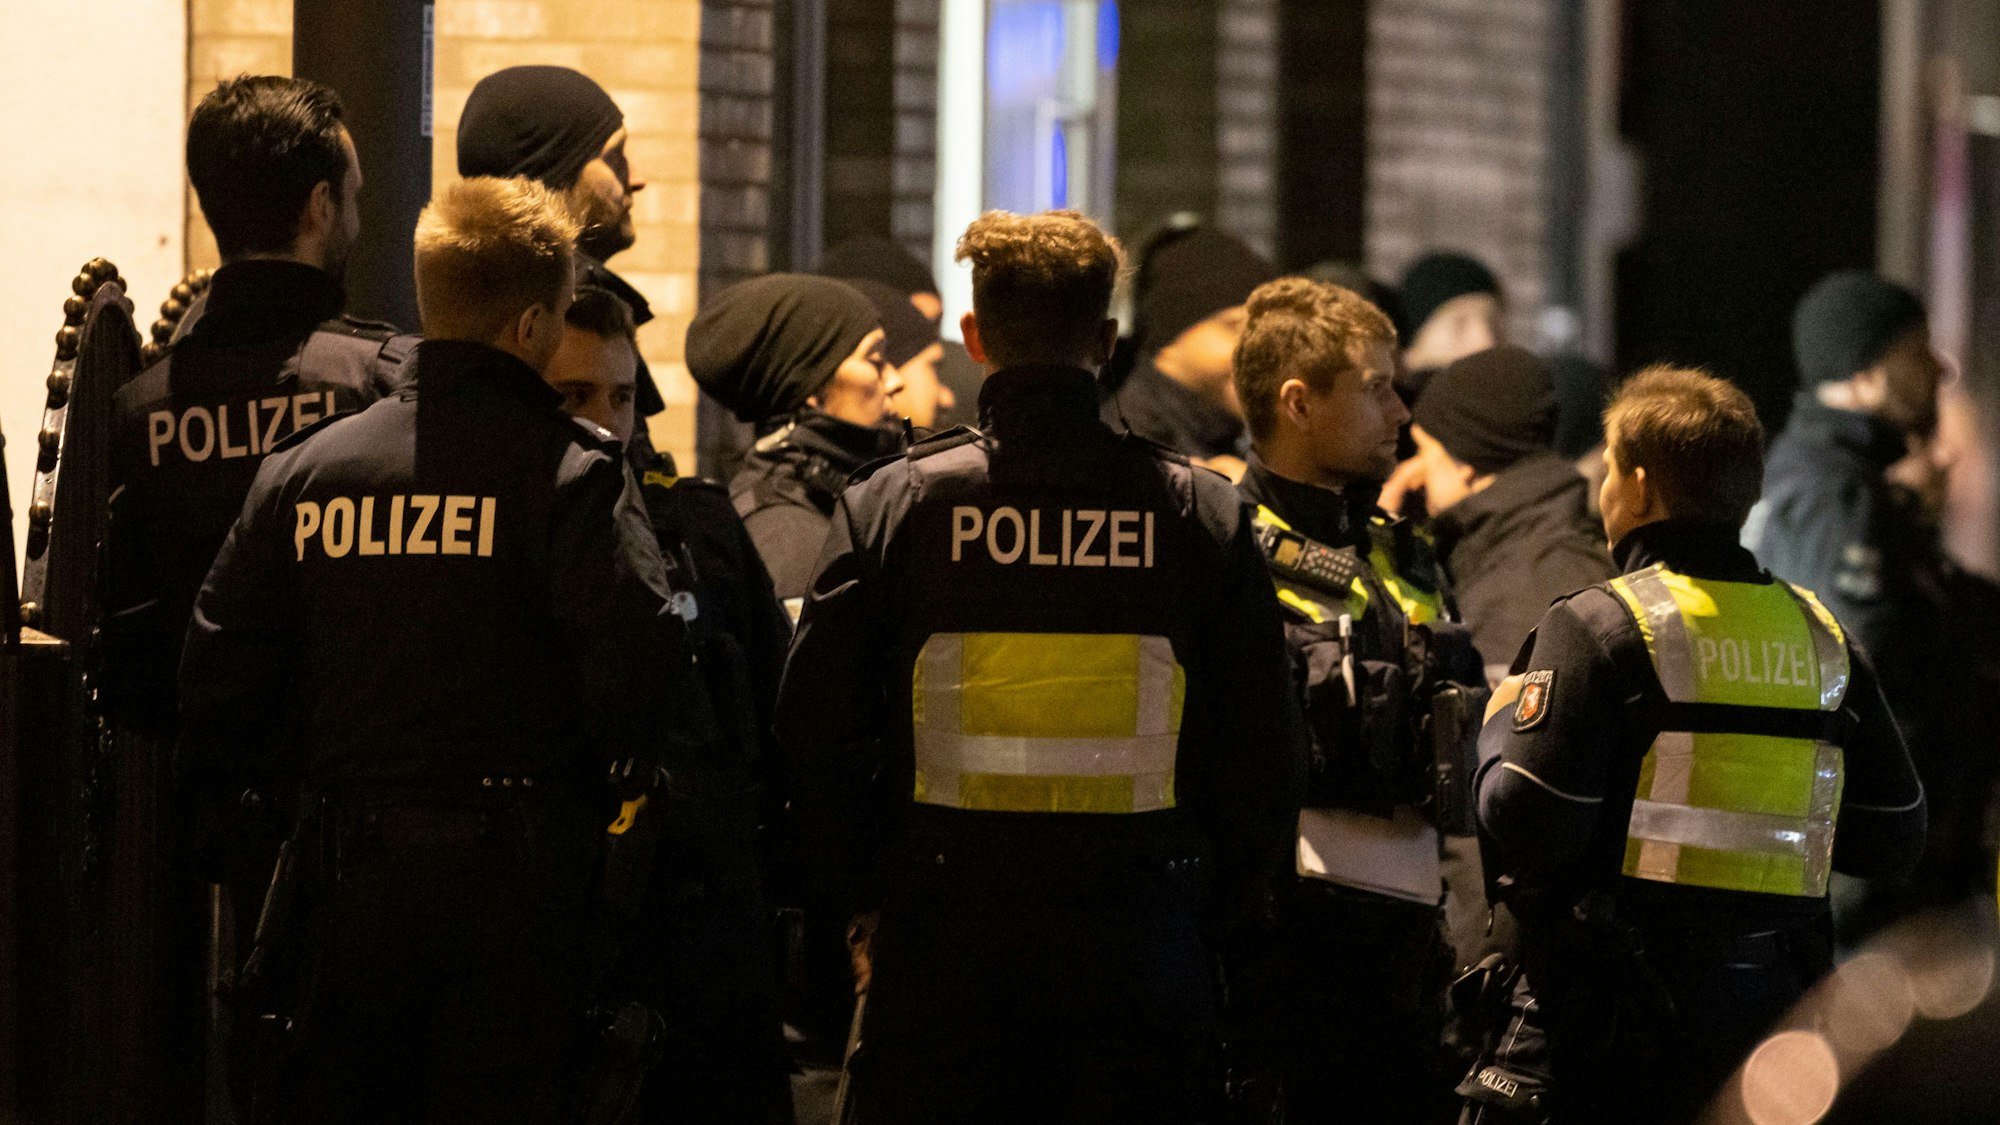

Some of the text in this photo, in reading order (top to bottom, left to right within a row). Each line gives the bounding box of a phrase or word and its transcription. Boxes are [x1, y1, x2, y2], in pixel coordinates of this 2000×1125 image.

[294, 494, 496, 562] POLIZEI
[951, 505, 1155, 568] POLIZEI
[1697, 636, 1817, 688] POLIZEI
[1479, 1069, 1518, 1097] POLIZEI
